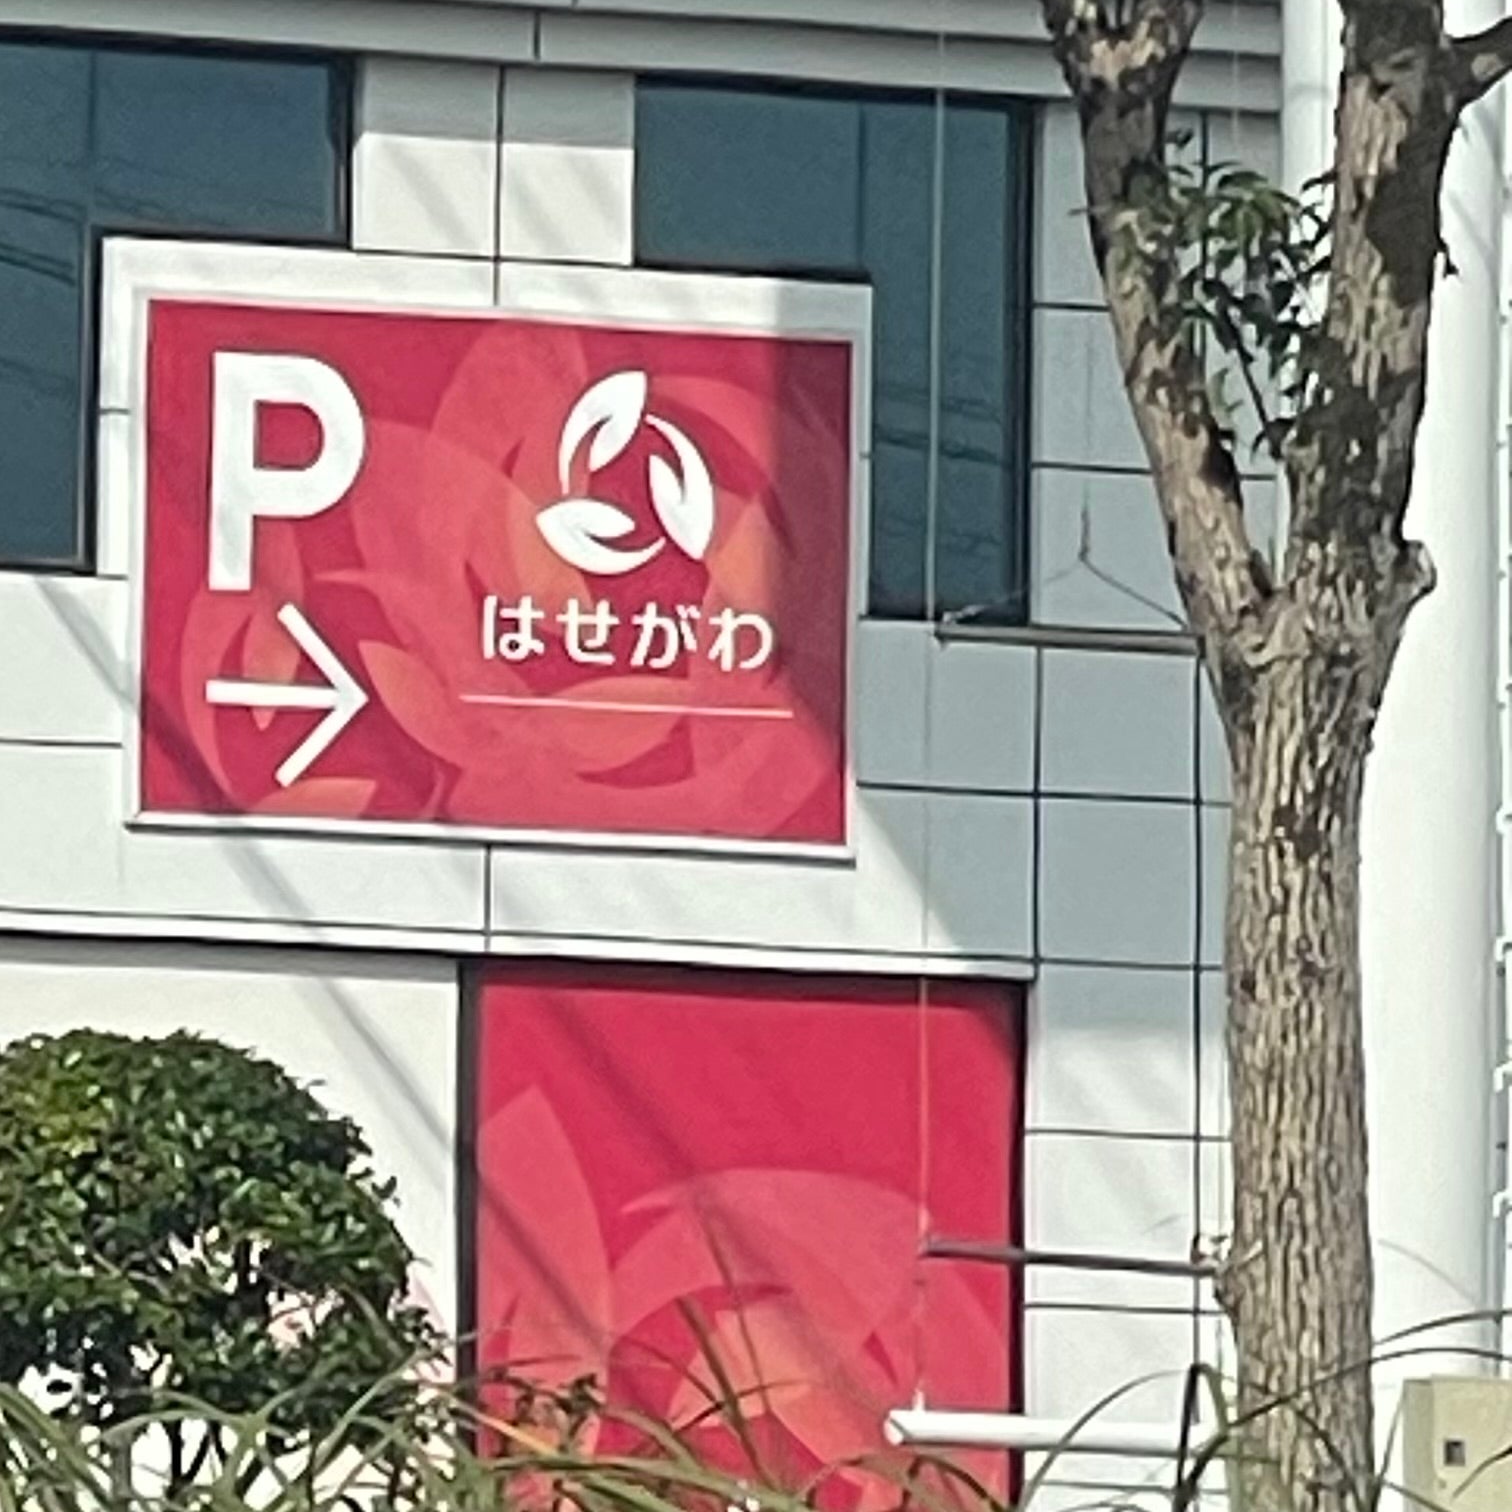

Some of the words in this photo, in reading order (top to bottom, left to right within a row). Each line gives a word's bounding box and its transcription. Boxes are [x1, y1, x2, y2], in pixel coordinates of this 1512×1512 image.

[207, 351, 366, 592] P
[480, 594, 775, 672] はせがわ
